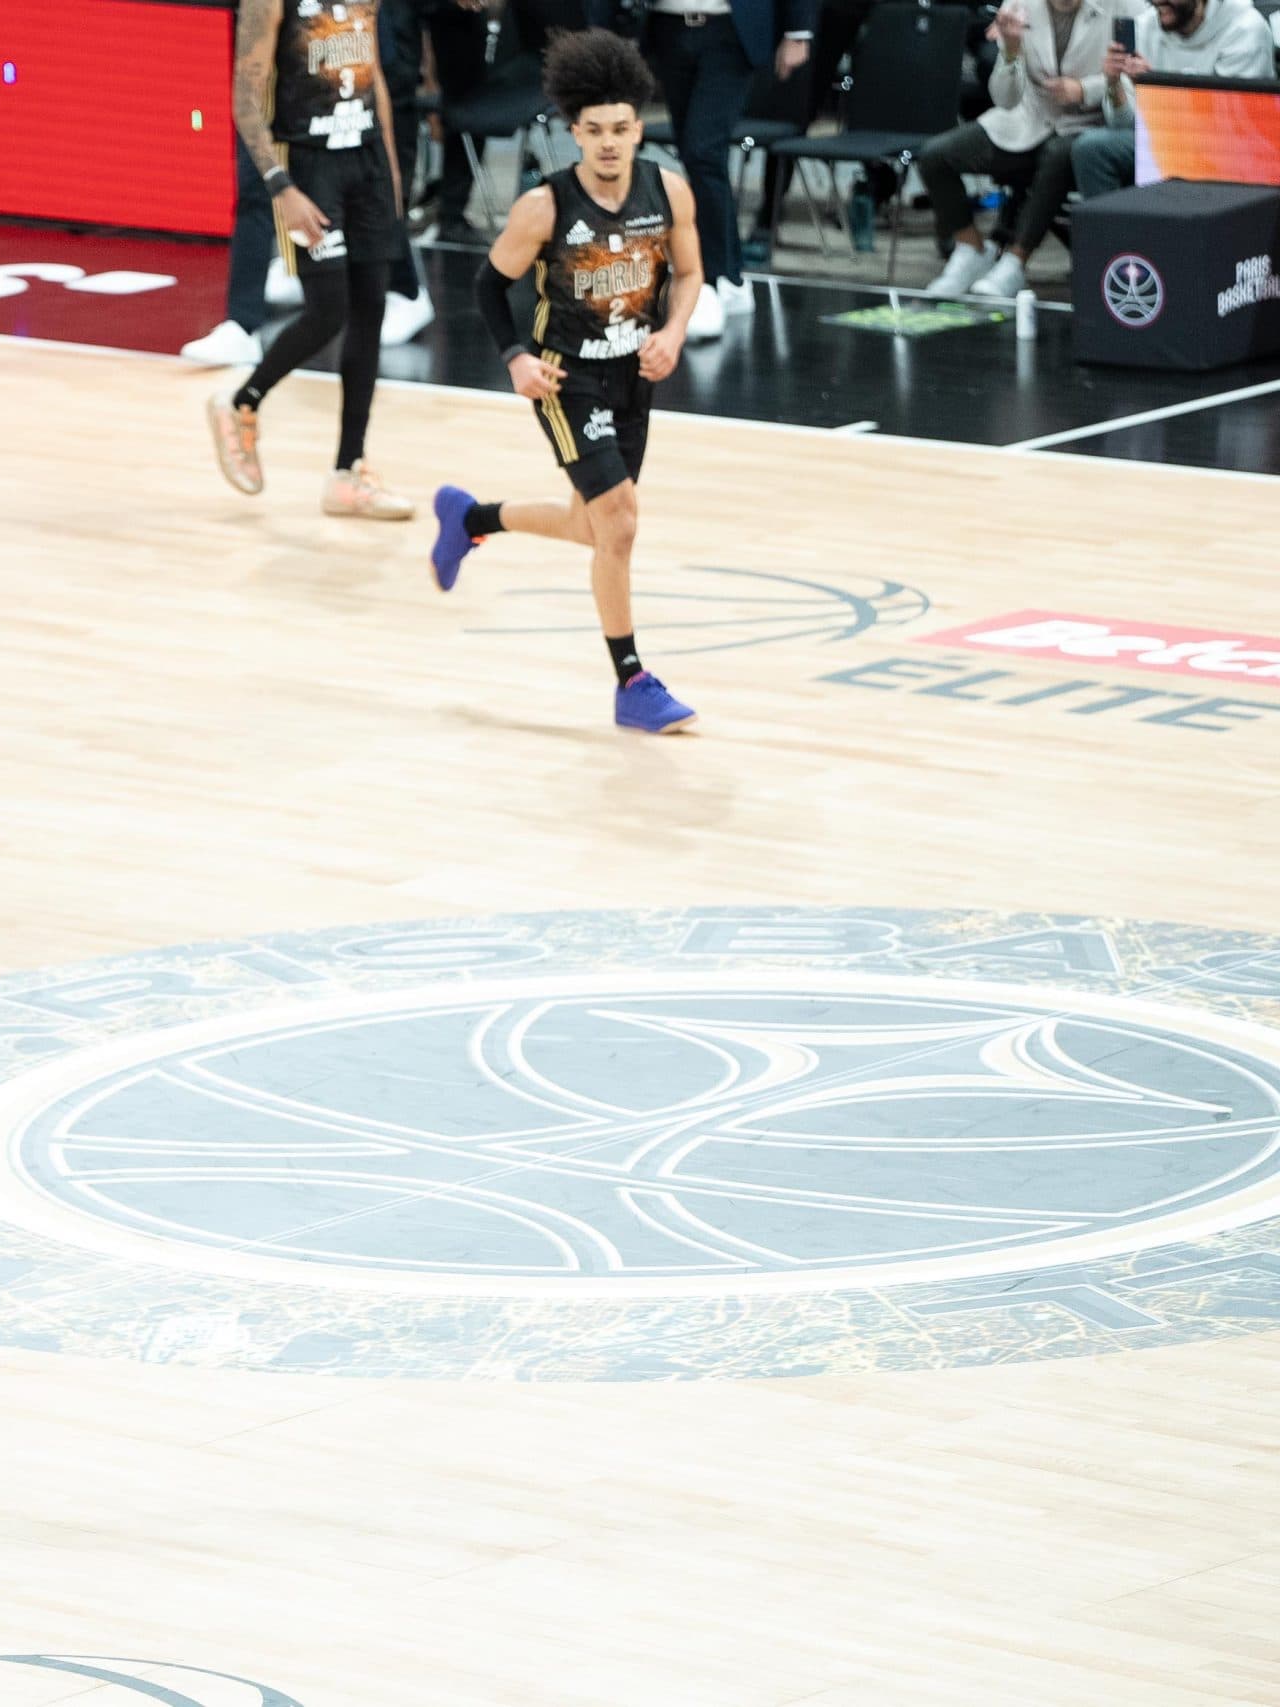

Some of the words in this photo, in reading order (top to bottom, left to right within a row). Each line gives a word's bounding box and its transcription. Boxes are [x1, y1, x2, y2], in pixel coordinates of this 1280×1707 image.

[339, 67, 355, 99] 3
[574, 257, 651, 300] PARIS
[1236, 254, 1272, 284] PARIS
[609, 298, 625, 325] 2
